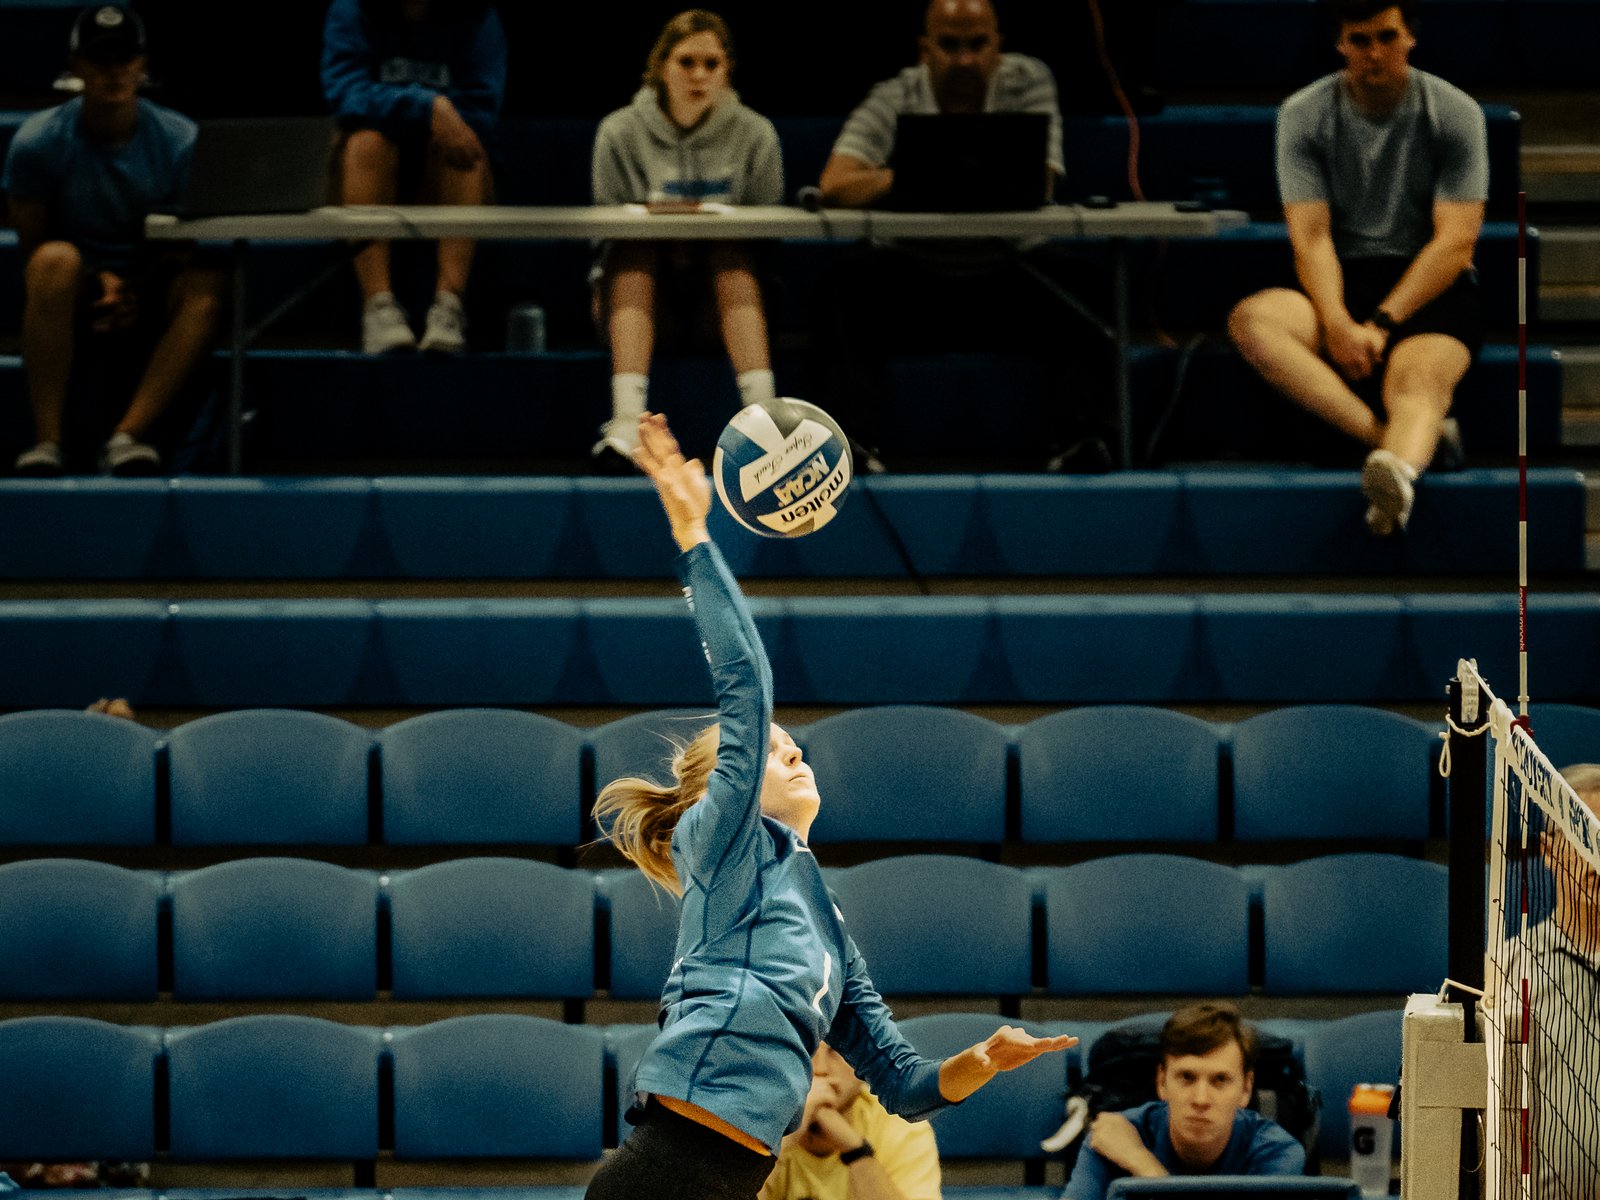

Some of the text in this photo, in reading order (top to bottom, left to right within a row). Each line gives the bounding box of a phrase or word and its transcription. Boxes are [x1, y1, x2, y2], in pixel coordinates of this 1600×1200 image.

[772, 451, 830, 507] NCAA
[780, 470, 844, 523] molten
[1353, 1126, 1375, 1155] G
